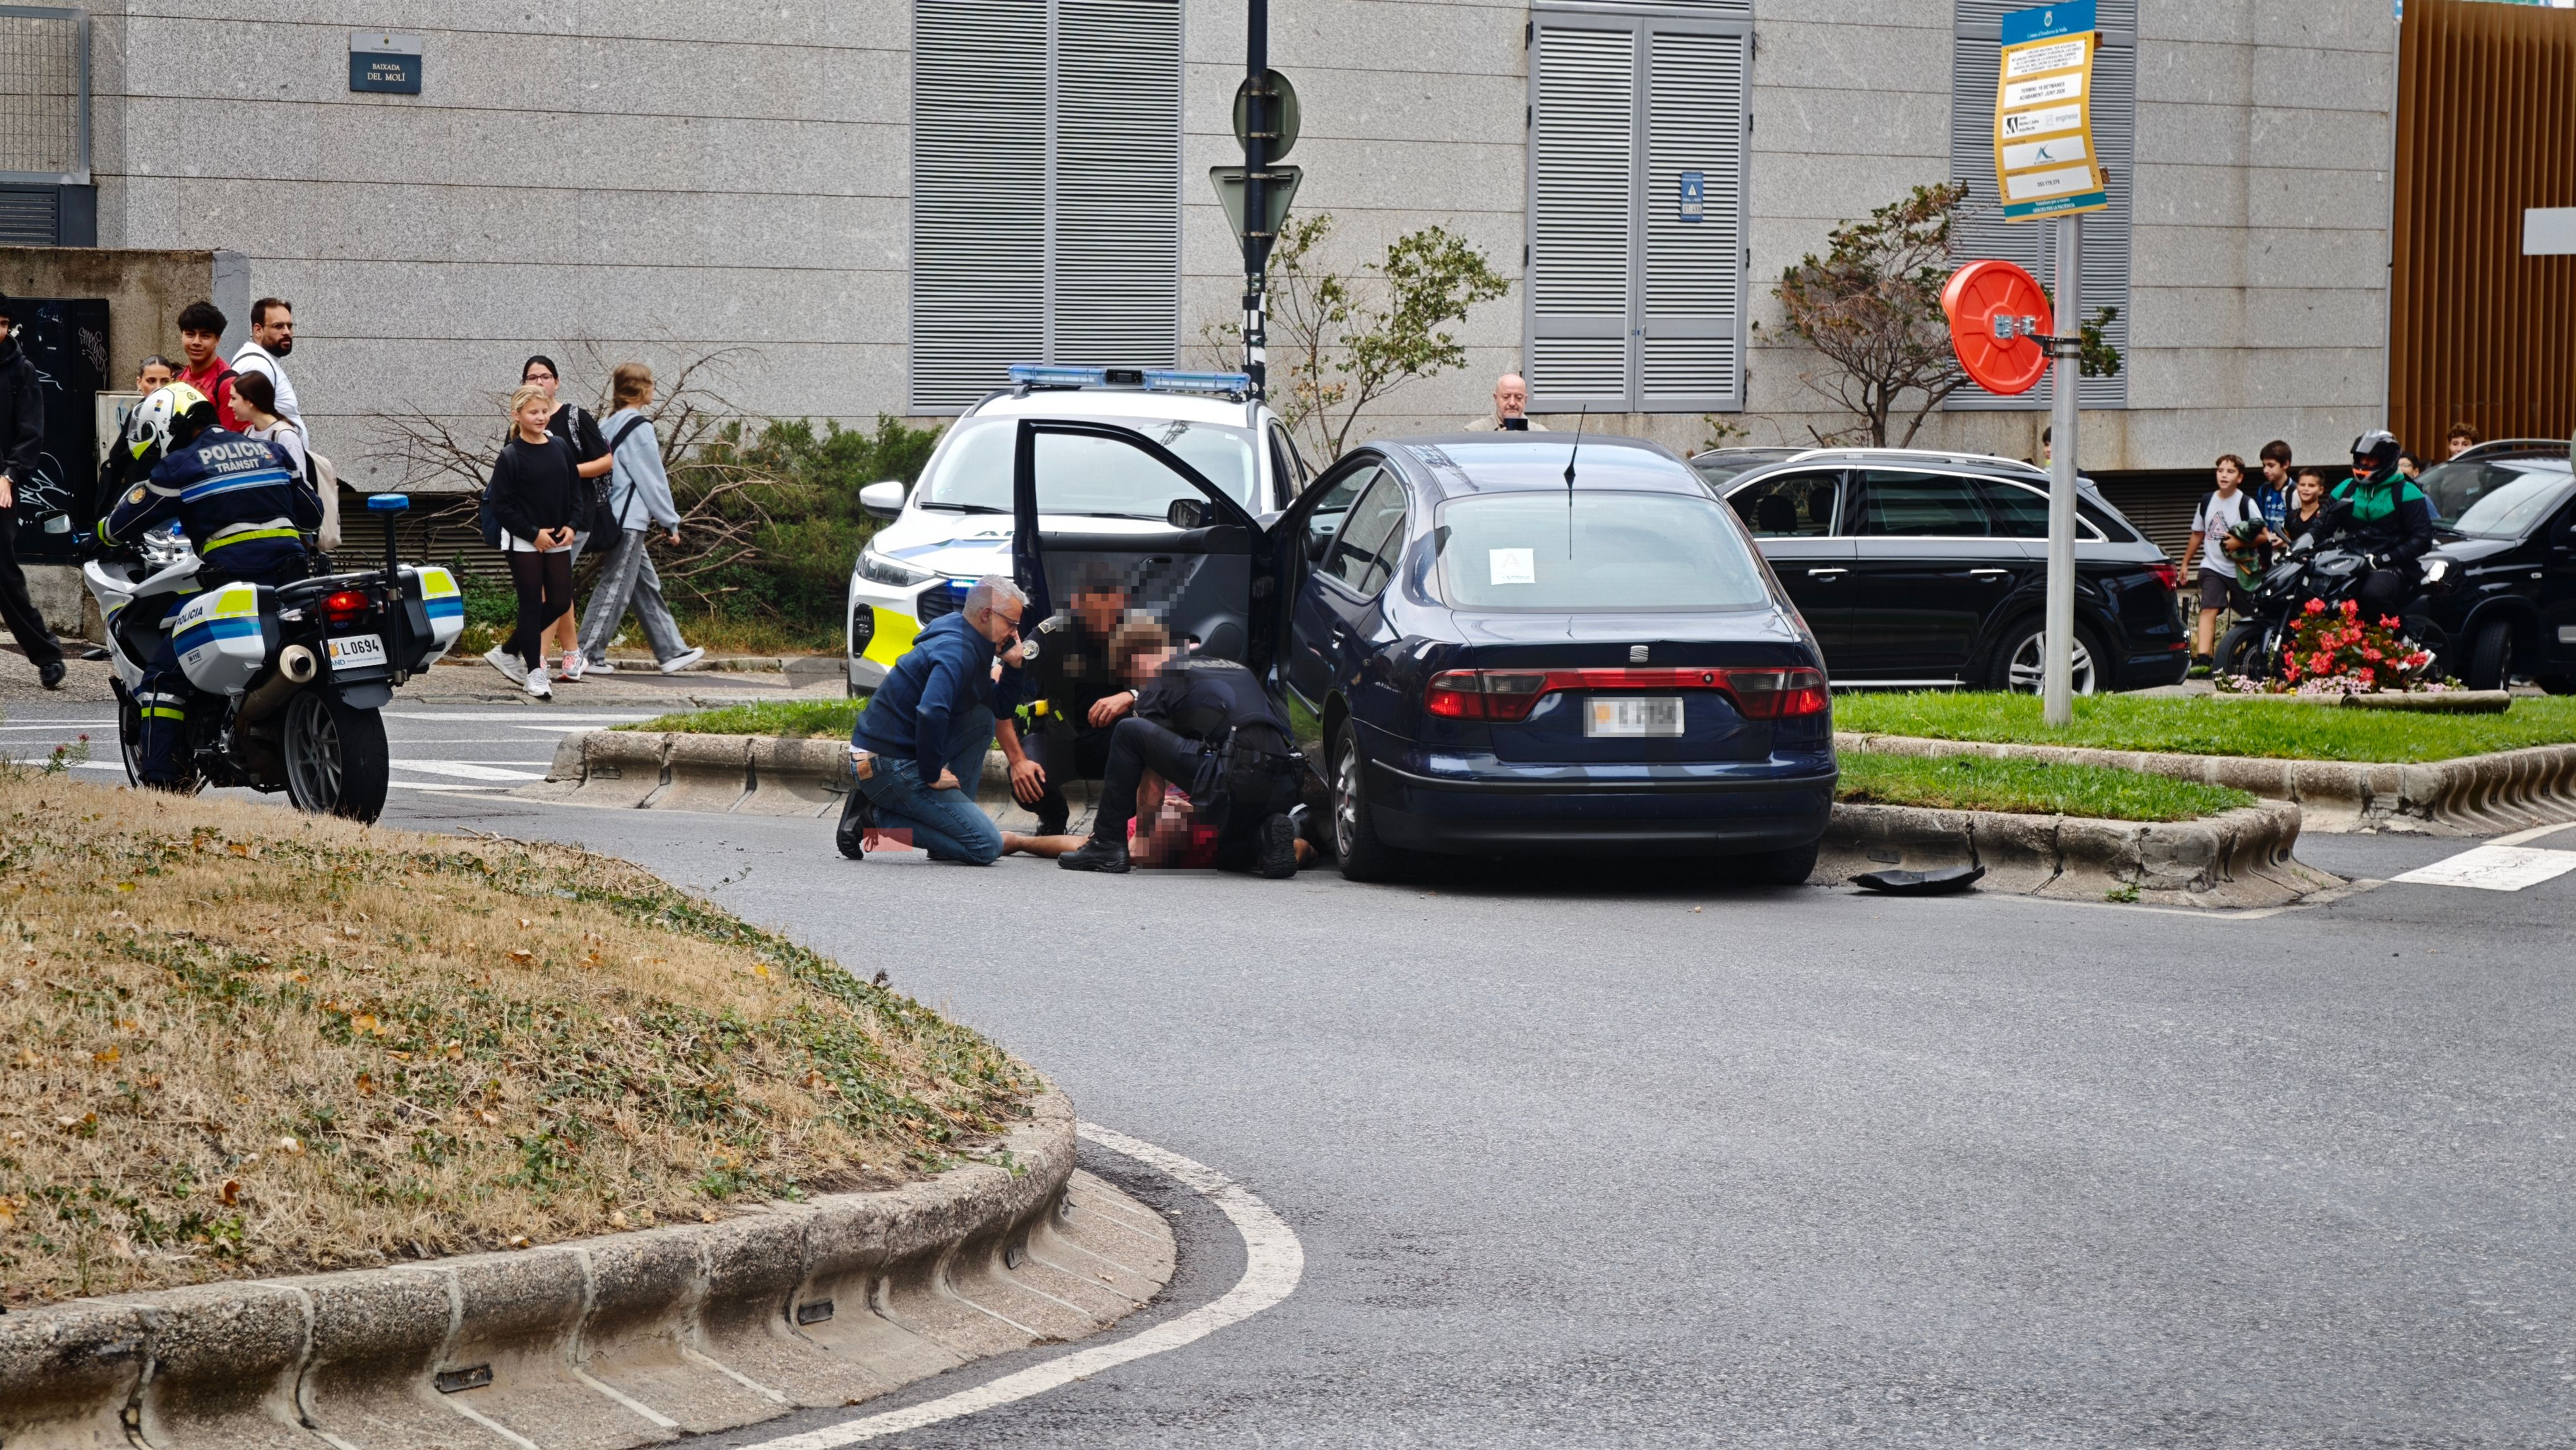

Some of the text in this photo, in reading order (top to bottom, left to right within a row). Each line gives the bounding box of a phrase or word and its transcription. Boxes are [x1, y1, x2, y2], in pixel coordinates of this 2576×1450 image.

[367, 72, 405, 81] DEL MOLÍ
[198, 442, 271, 465] POLICIA
[215, 458, 259, 473] TRÀNSIT
[176, 606, 203, 627] POLICIA
